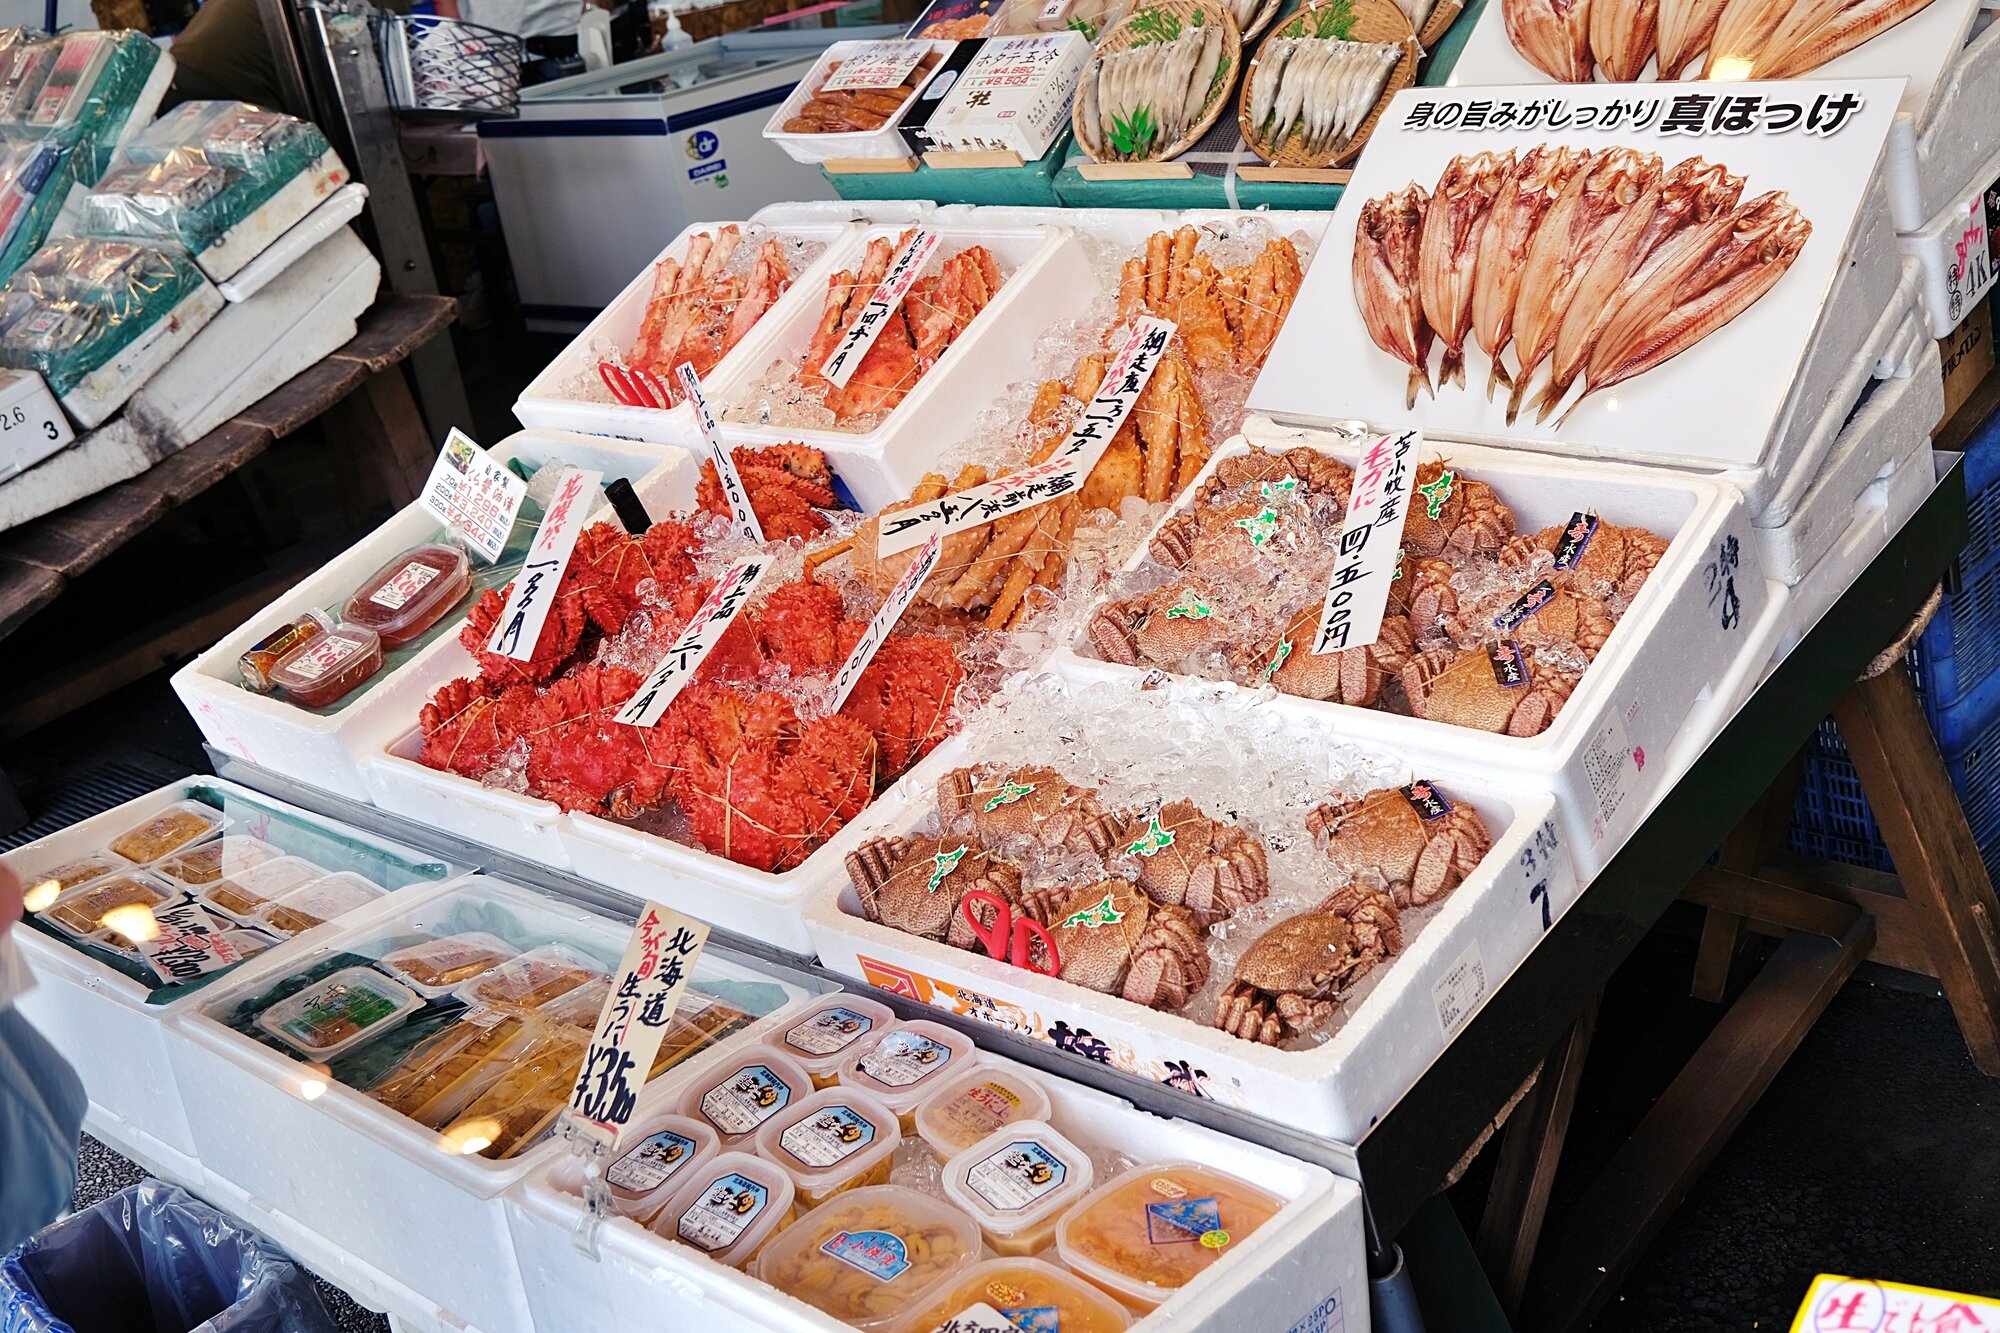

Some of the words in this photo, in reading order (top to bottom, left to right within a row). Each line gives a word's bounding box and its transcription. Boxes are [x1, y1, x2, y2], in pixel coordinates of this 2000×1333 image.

[976, 48, 1060, 68] ホタテ玉冷
[1406, 99, 1659, 130] 身の旨みがしっかり
[1659, 94, 1858, 134] 真ほっけ
[1113, 326, 1167, 397] 網走産
[43, 420, 59, 441] 3
[485, 464, 511, 489] 自家製
[1352, 435, 1392, 511] 毛がに
[1373, 430, 1417, 528] 苫小牧産
[452, 492, 493, 531] ¥3,240
[458, 480, 500, 519] ¥1,296
[709, 563, 762, 623] 特上品
[638, 908, 669, 981] 今が旬
[636, 926, 699, 1028] 北海道
[602, 971, 642, 1048] 生うに
[956, 987, 999, 1012] 北海道
[968, 1004, 1034, 1037] オホーツク
